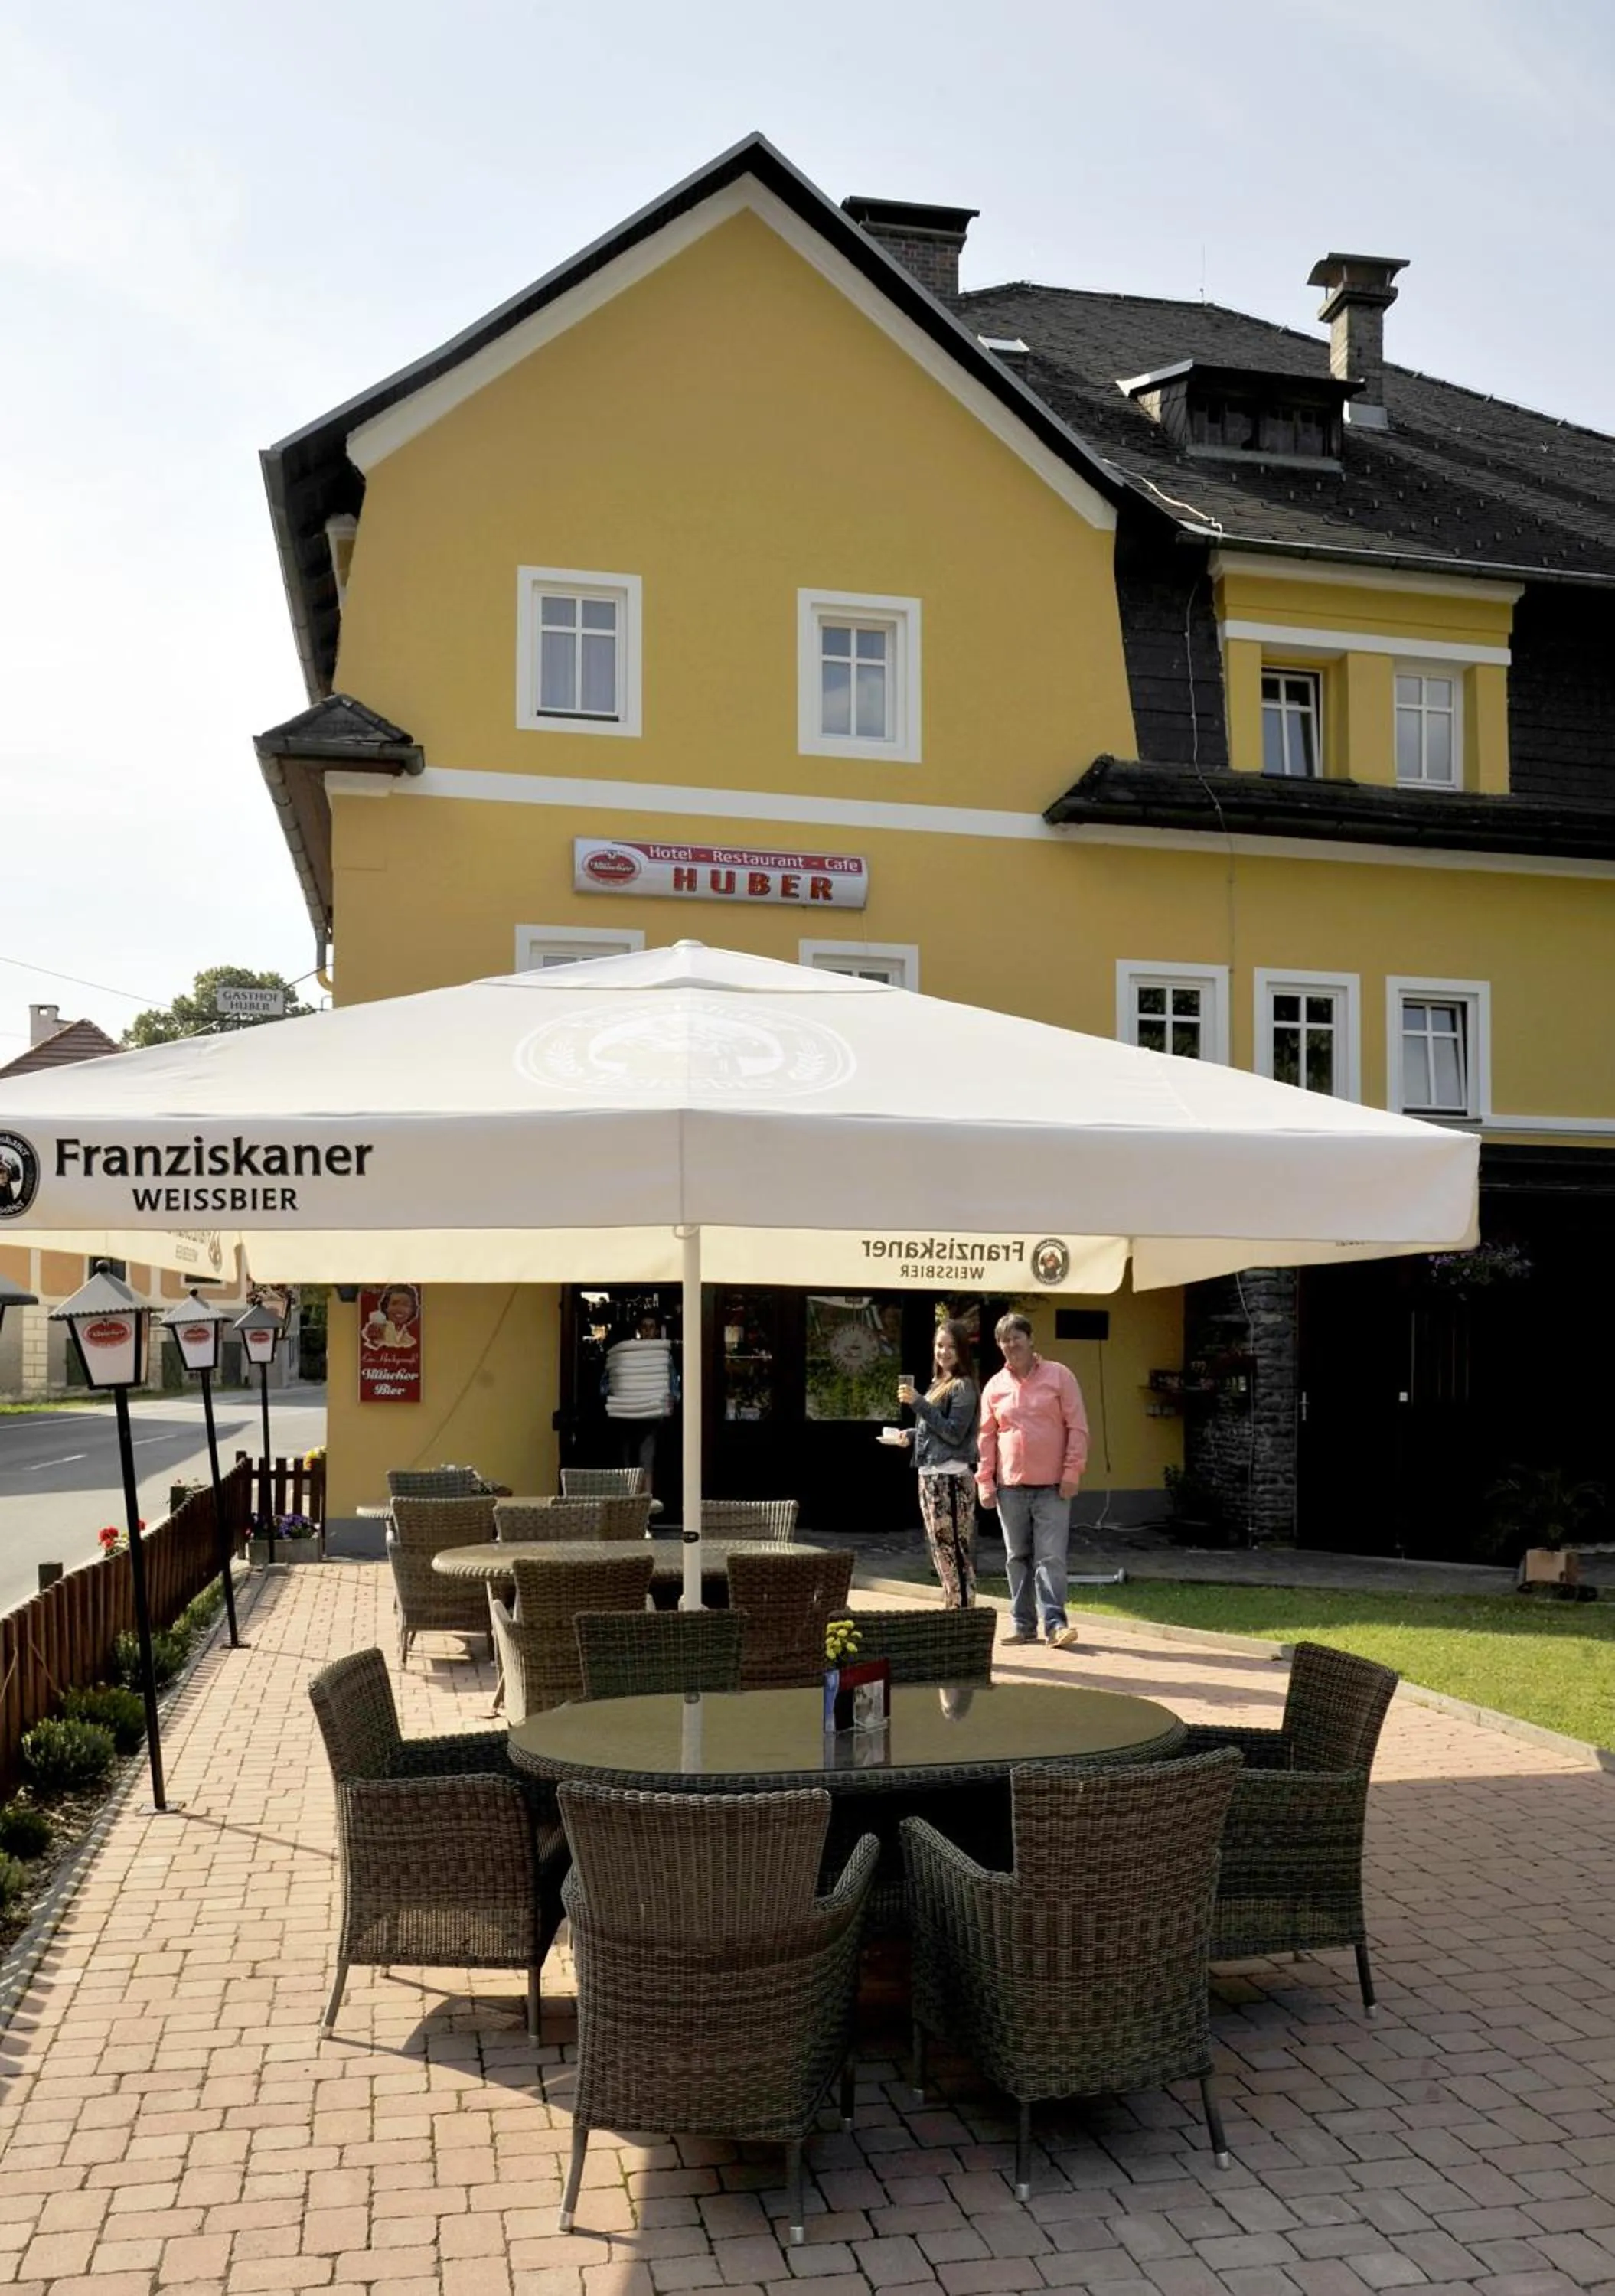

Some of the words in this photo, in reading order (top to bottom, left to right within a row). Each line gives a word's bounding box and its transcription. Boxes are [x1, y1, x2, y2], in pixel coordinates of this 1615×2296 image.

[649, 846, 693, 861] Hotel
[713, 850, 804, 869] Restaurant
[674, 866, 833, 901] HUBER
[223, 991, 277, 1002] GASTHOF
[230, 1001, 270, 1011] HUBER
[55, 1135, 374, 1177] Franziskaner
[132, 1188, 299, 1212] WEISSBIER
[374, 1383, 405, 1396] Bier
